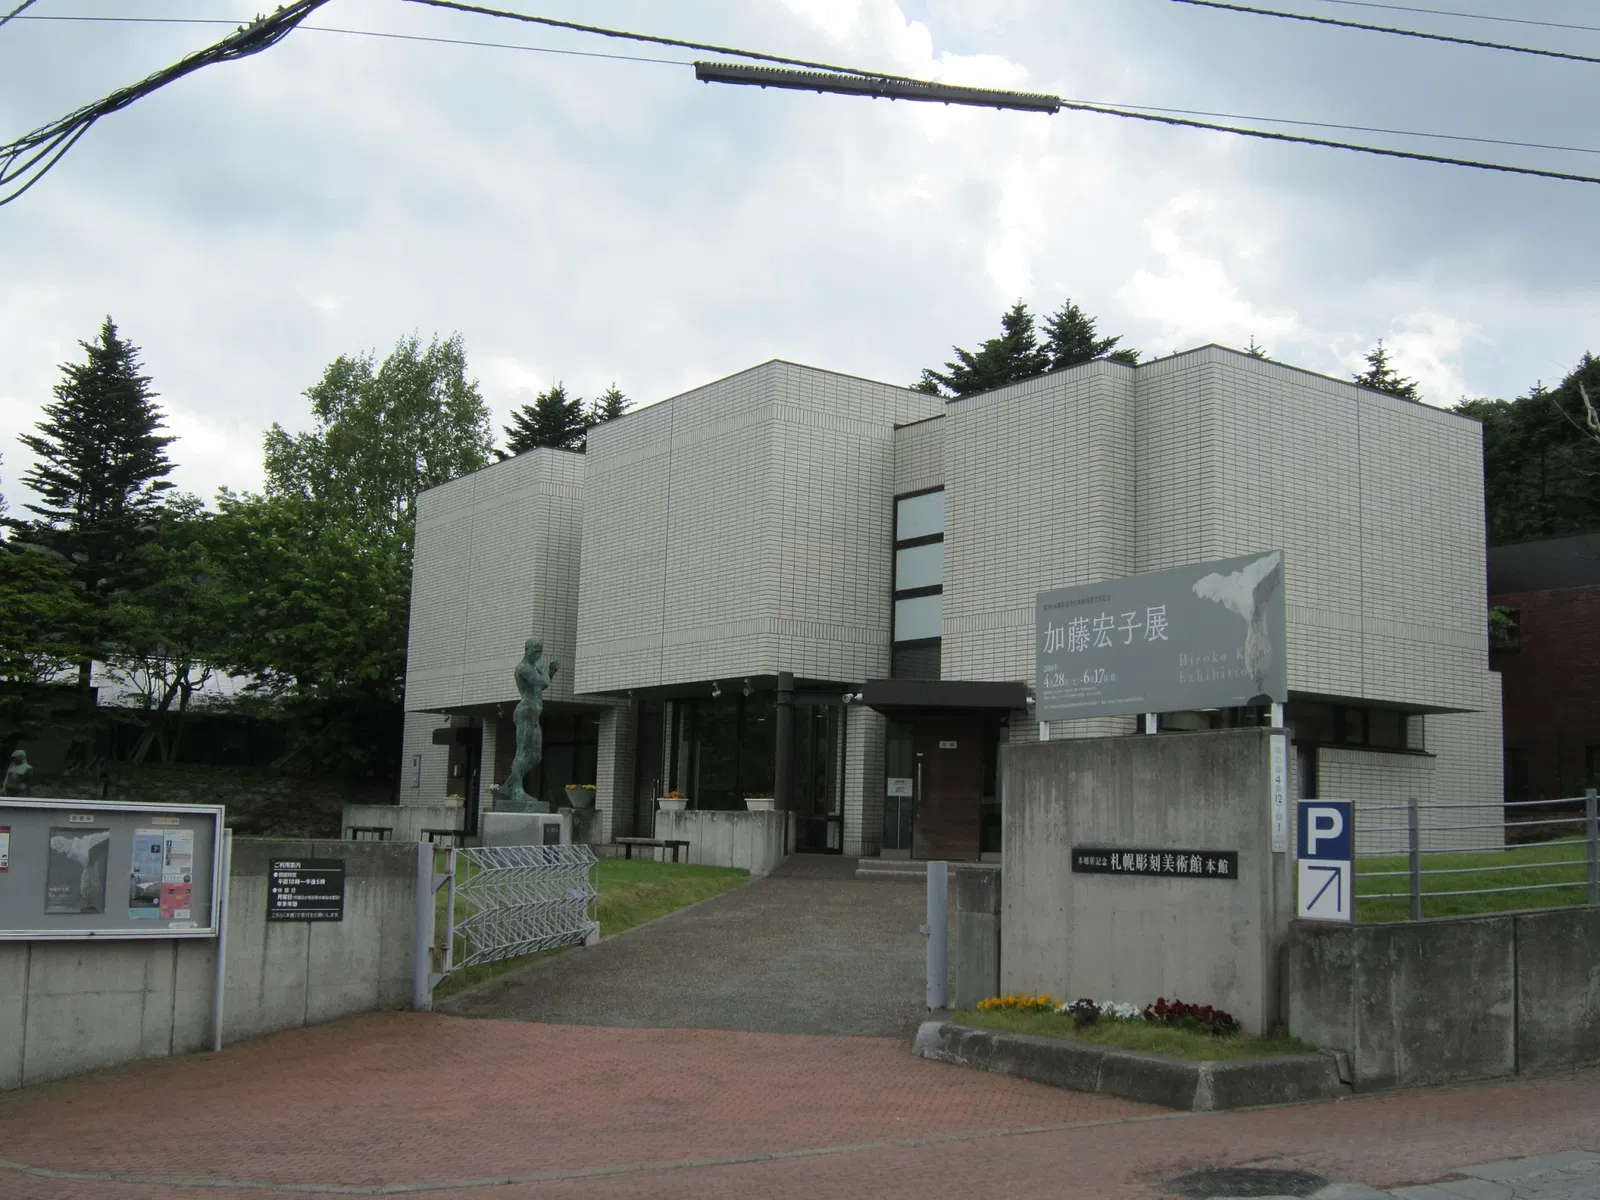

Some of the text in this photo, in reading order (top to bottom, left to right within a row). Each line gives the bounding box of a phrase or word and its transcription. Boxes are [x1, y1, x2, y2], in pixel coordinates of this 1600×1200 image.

[1043, 604, 1169, 654] 加藤宏子展
[1179, 650, 1227, 667] Hiroko
[1307, 807, 1343, 855] P
[1110, 853, 1203, 873] 札幌彫刻美術館
[1205, 859, 1229, 874] 本館
